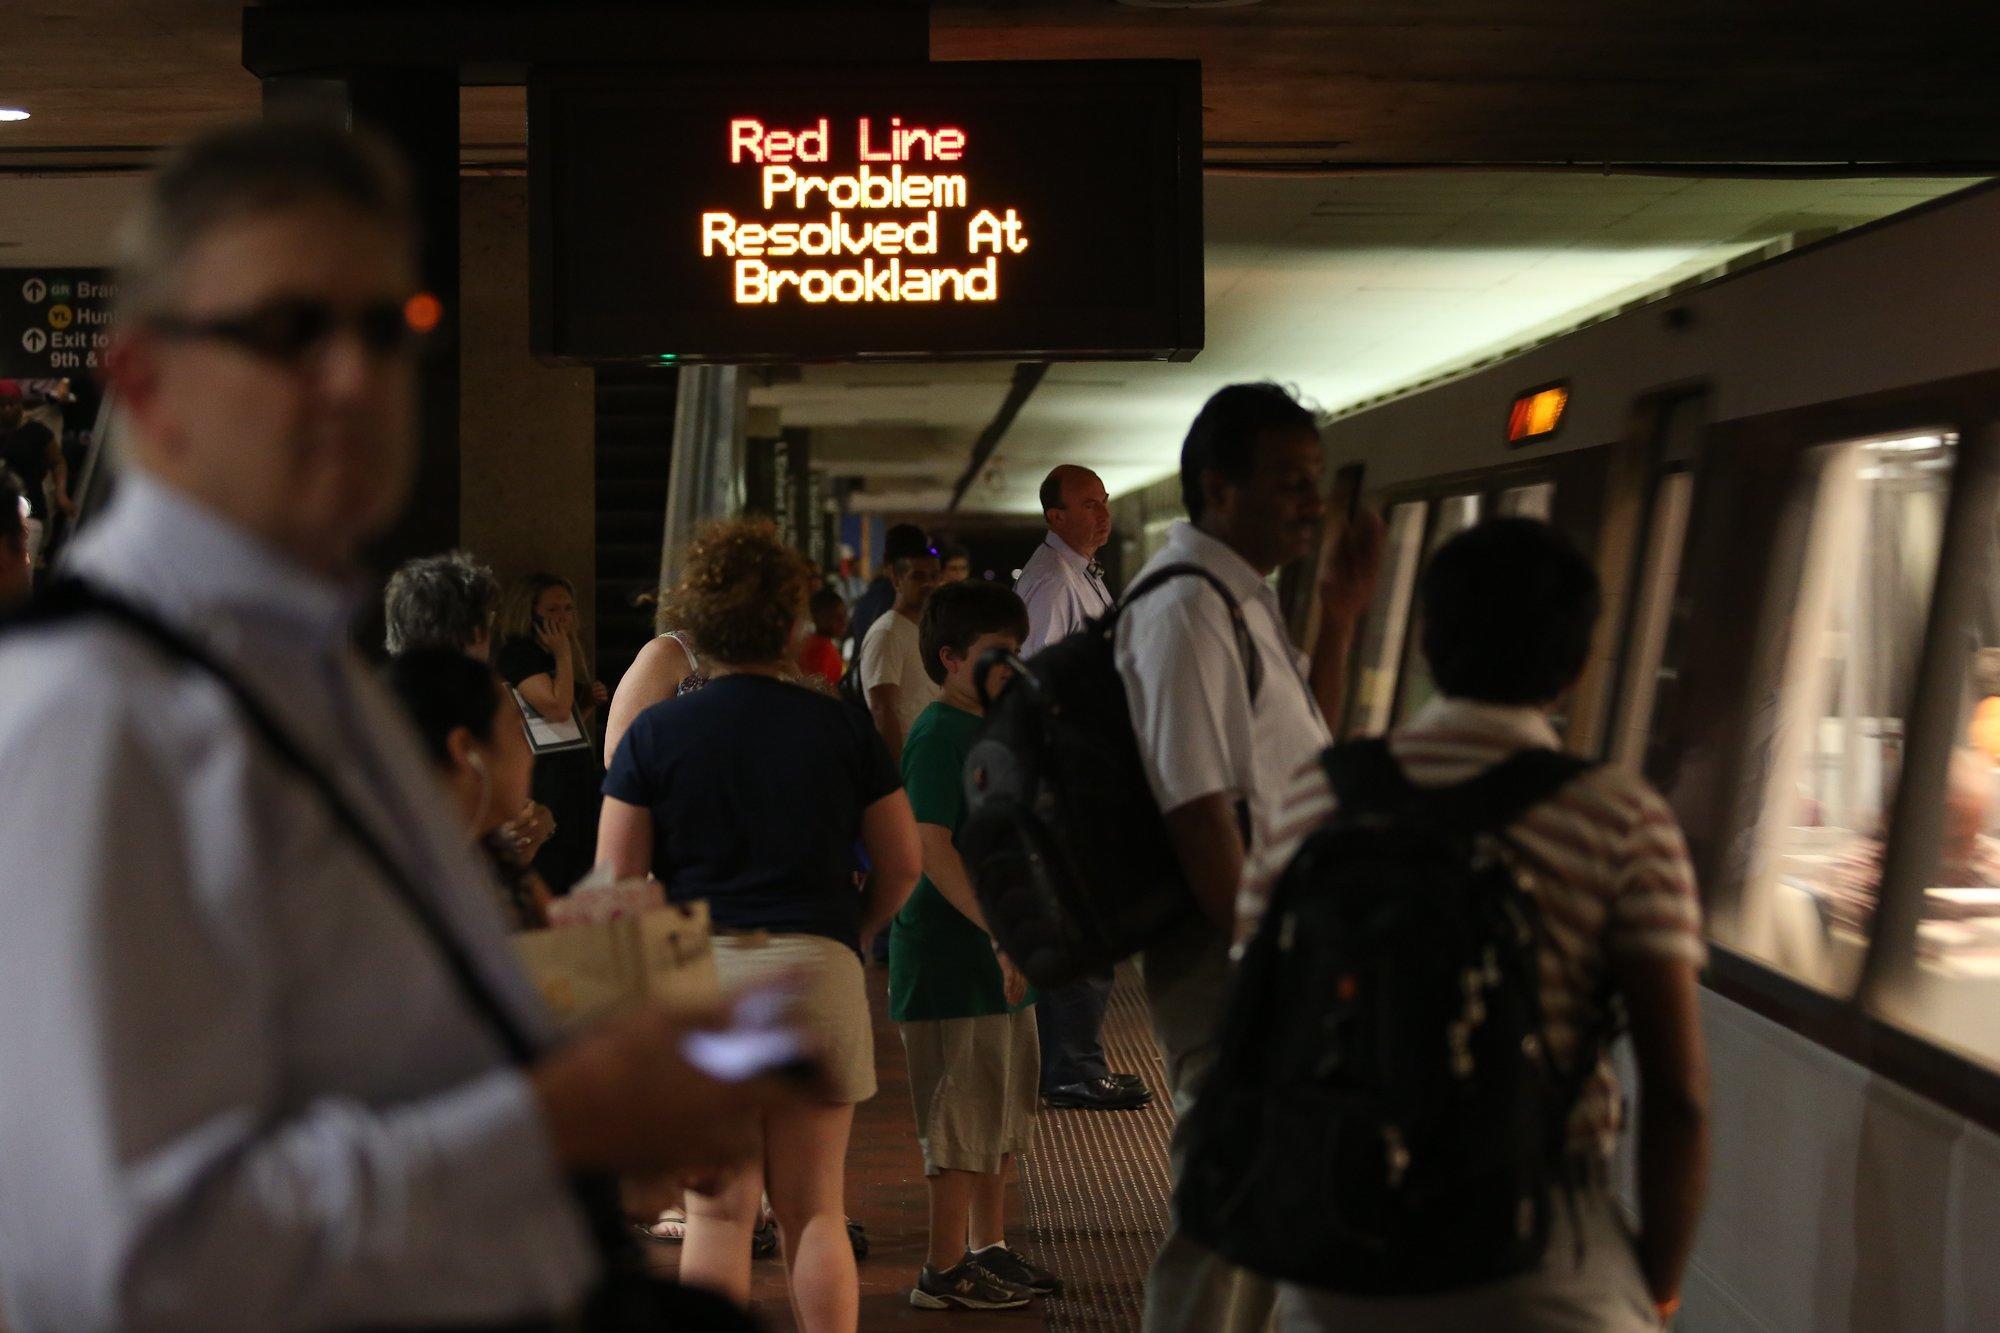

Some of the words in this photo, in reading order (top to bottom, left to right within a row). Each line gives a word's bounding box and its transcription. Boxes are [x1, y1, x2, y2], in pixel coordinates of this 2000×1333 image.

[730, 117, 828, 163] Red
[859, 117, 966, 161] Line
[763, 164, 967, 209] Problem
[702, 210, 938, 256] Resolved
[967, 208, 1028, 253] At
[735, 256, 998, 303] Brookland
[51, 331, 87, 348] Exit
[91, 332, 109, 348] to
[51, 351, 79, 368] 9th
[85, 351, 98, 368] &
